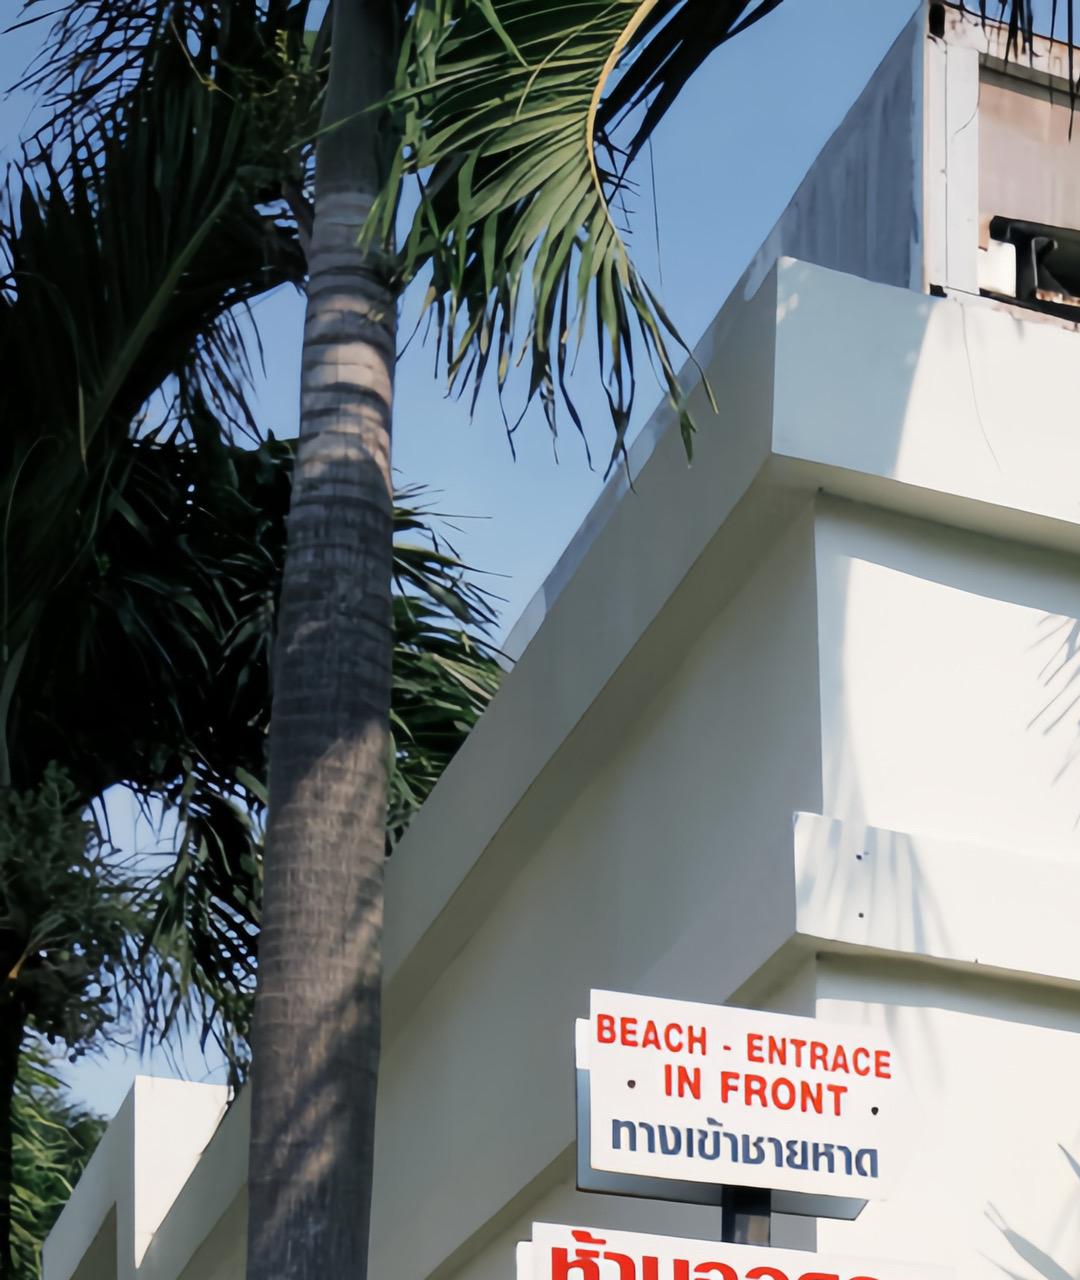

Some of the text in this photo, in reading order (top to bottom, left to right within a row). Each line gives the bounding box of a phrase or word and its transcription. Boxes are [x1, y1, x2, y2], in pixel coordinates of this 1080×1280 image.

[595, 1012, 708, 1057] BEACH
[745, 1031, 893, 1081] ENTRACE
[663, 1062, 849, 1118] IN FRONT
[610, 1116, 879, 1179] ทางเข้าชายหาด
